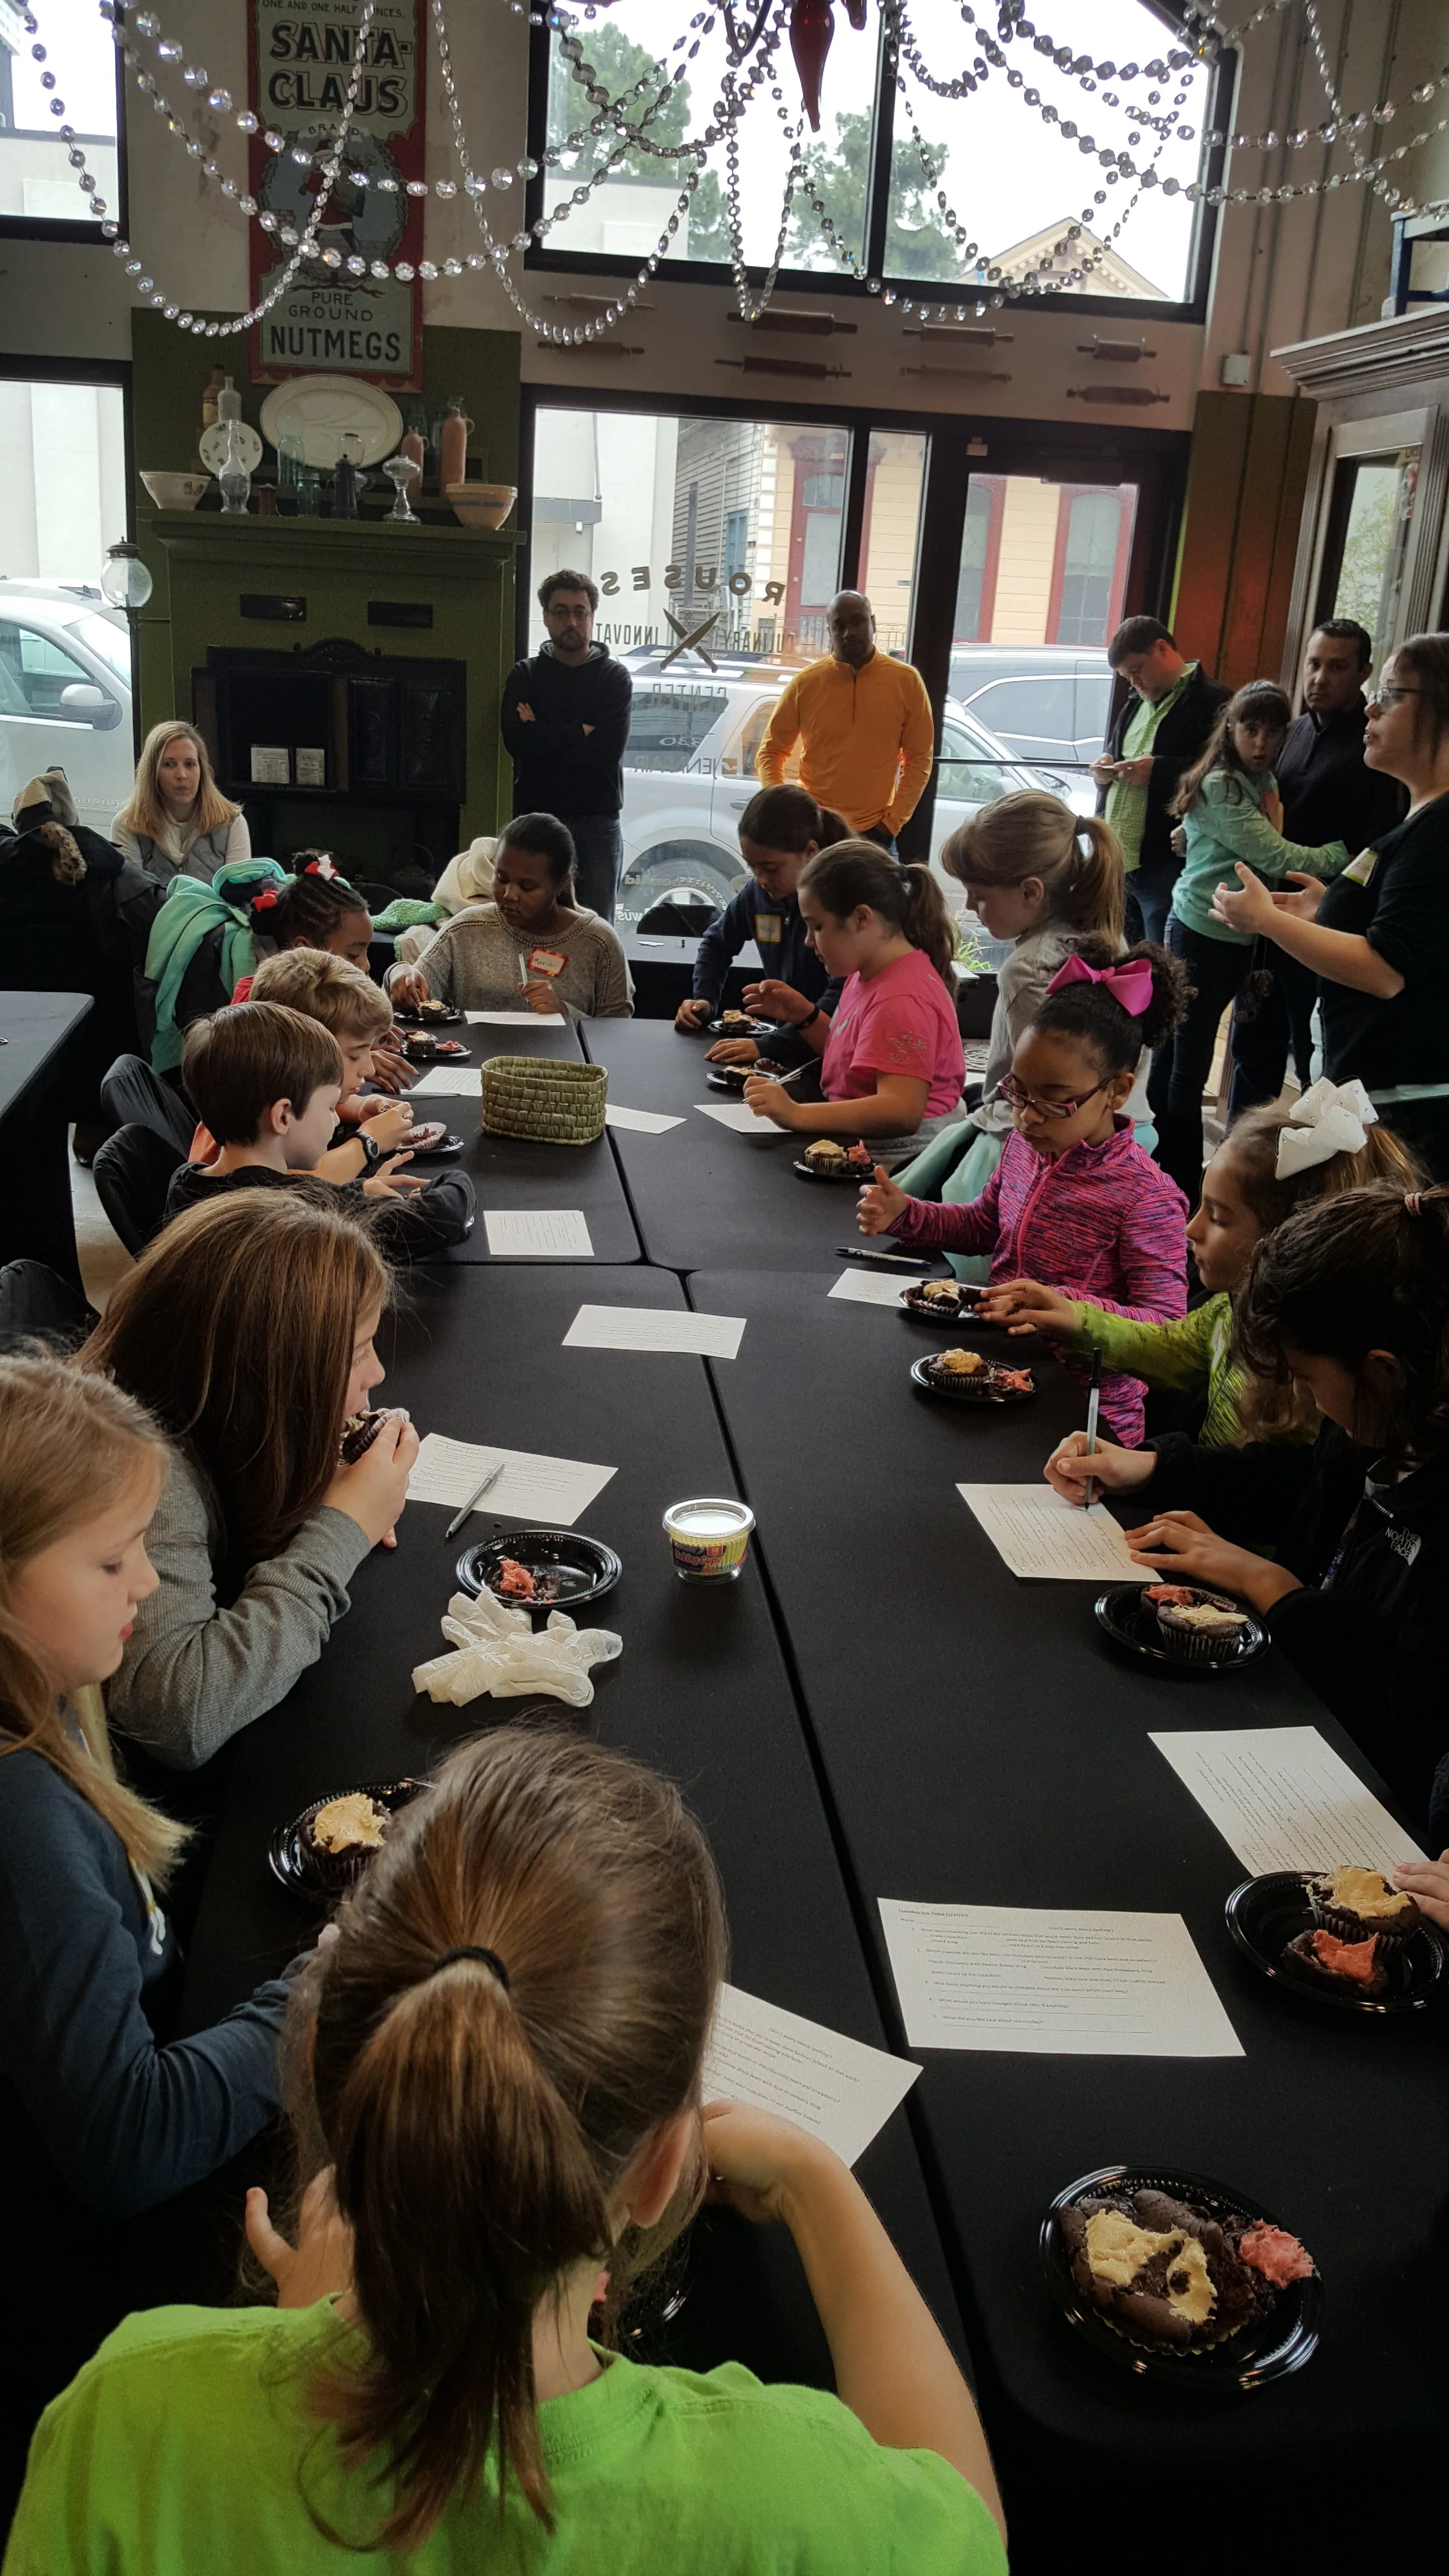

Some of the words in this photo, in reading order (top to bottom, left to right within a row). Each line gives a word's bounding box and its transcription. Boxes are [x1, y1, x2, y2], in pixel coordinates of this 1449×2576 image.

[263, 0, 283, 8] ONE
[287, 1, 307, 10] AND
[311, 3, 330, 12] ONE
[334, 6, 358, 14] HALF
[365, 7, 406, 18] NCES.
[270, 20, 412, 70] SANTA-
[268, 70, 408, 118] CLAUS
[308, 123, 360, 136] BRAD
[311, 292, 354, 305] PURE
[289, 304, 374, 321] GROUND
[270, 326, 401, 362] NUTMEGS
[1385, 1527, 1415, 1551] NORTH
[1402, 1526, 1419, 1542] THE
[1390, 1540, 1411, 1559] FACE
